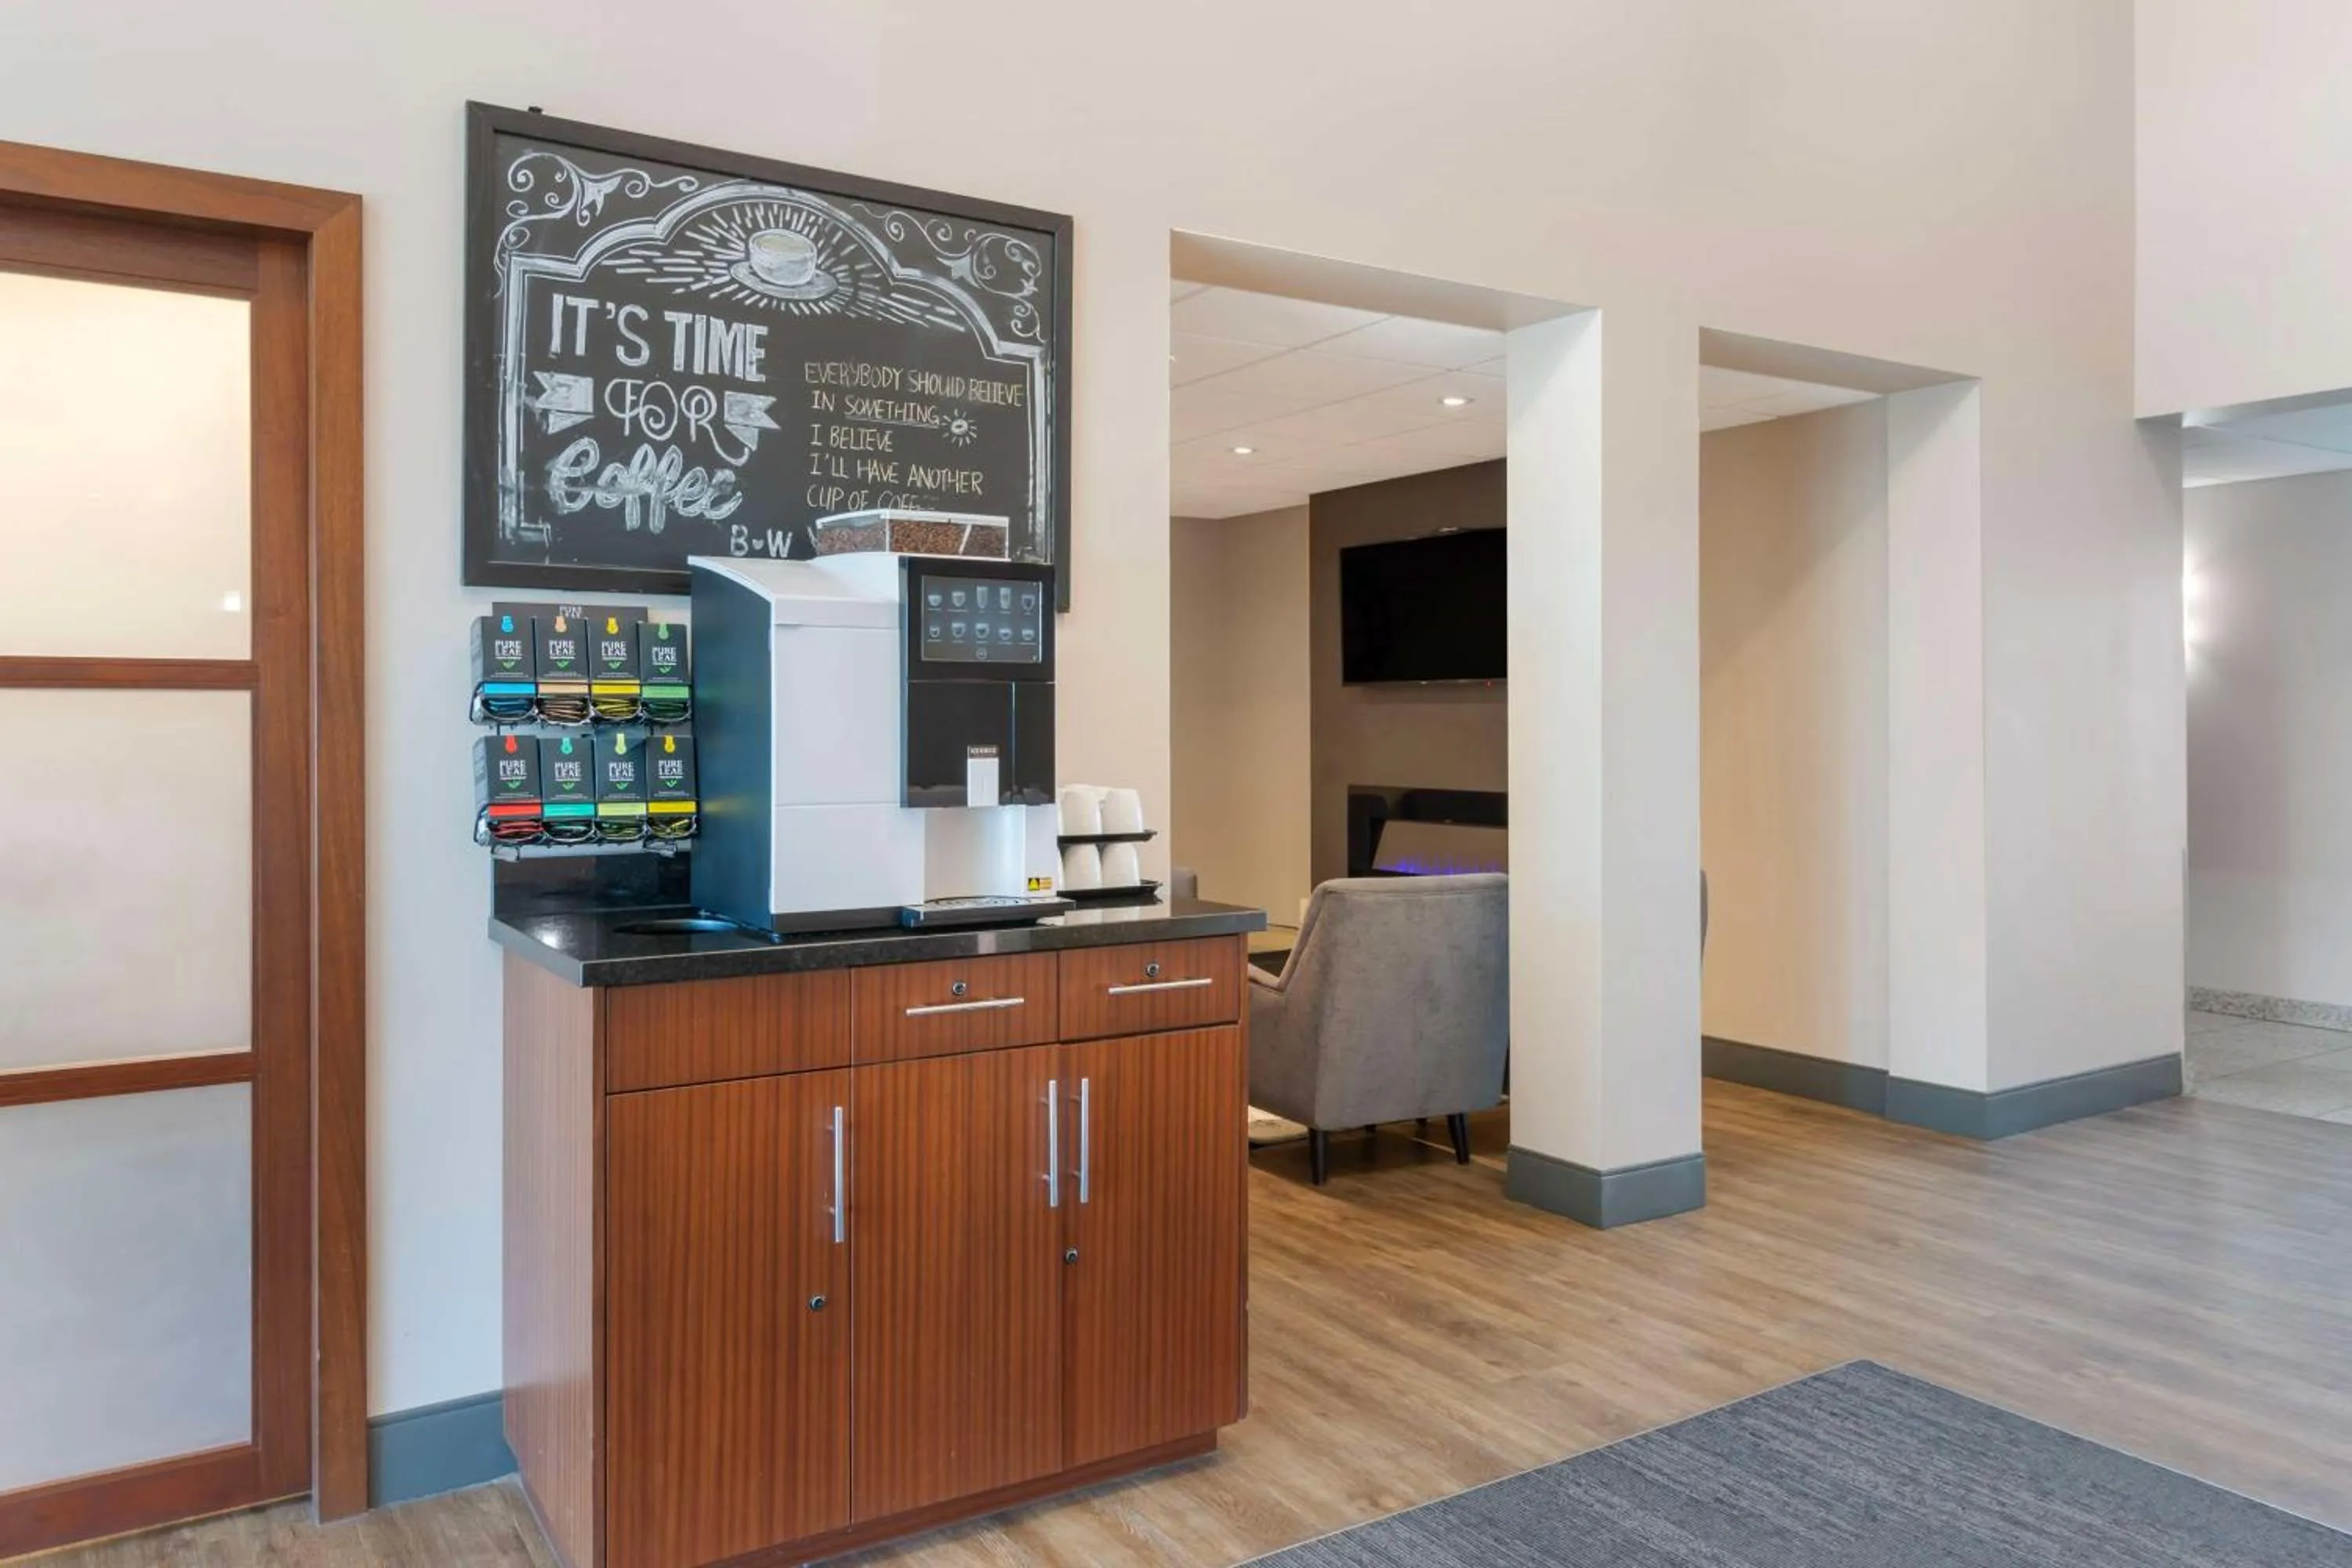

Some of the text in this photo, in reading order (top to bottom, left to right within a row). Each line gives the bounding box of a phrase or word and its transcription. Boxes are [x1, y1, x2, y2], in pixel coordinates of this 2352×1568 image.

[550, 293, 768, 383] IT'S TIME
[804, 361, 1023, 407] EVERYBODY SHOULD BELIEVE
[604, 378, 749, 466] FOR
[811, 390, 940, 426] IN SOMETHING
[810, 424, 894, 452] I BELIEVE
[546, 436, 743, 535] Coffee
[810, 452, 984, 495] I'LL HAVE ANOTHER
[806, 484, 845, 511] CUP
[848, 490, 869, 510] OF
